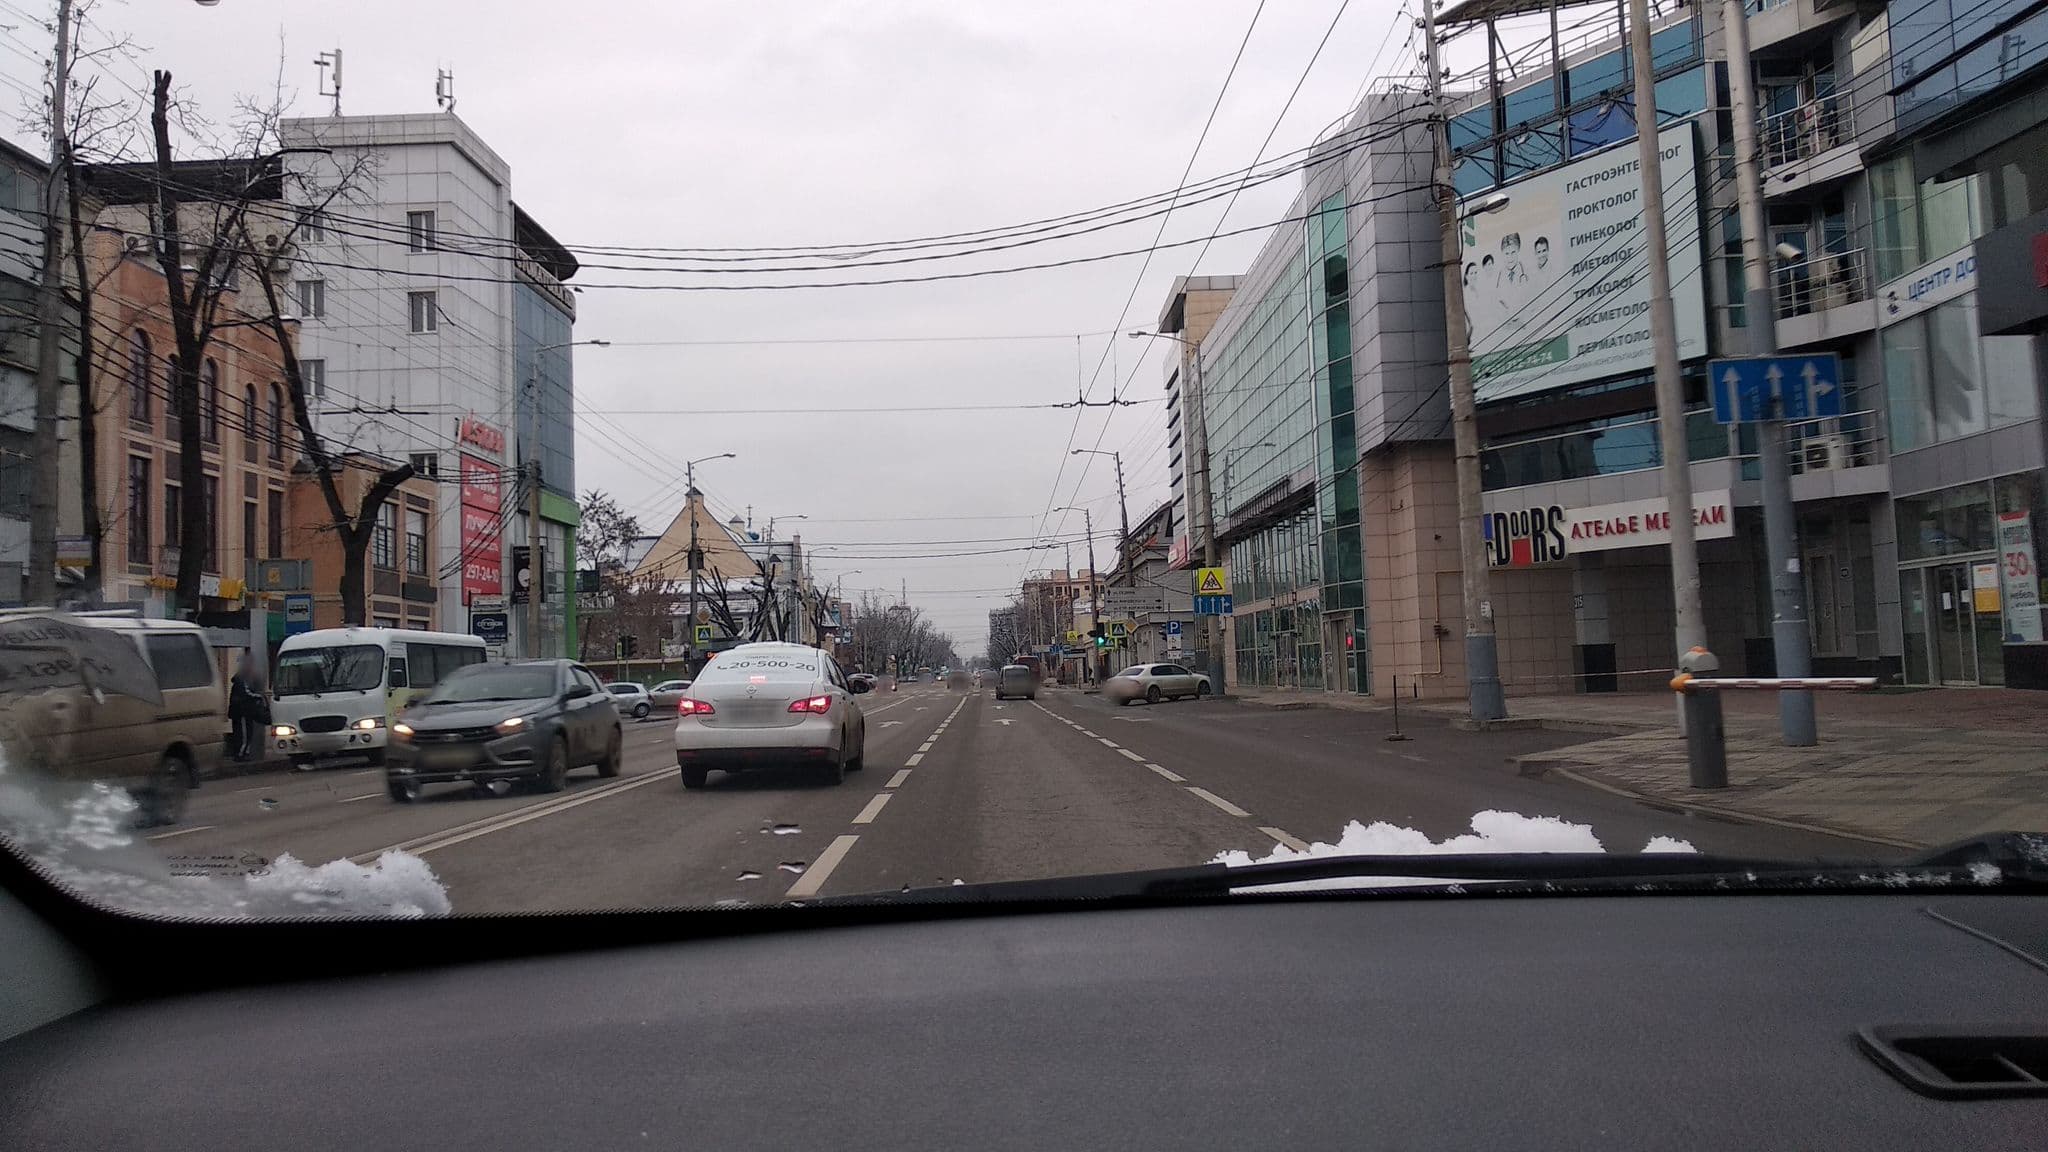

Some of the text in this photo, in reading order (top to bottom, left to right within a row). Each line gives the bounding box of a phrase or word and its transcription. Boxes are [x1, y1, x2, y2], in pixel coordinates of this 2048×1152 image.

[1566, 145, 1681, 194] ГАСТРОЭНТЕЛОГ
[1568, 188, 1638, 220] ПРОКТОЛОГ
[1570, 216, 1639, 247] ГИНЕКОЛОГ
[1571, 247, 1633, 277] ДИЕТОЛОГ
[1573, 275, 1636, 300] ТРИХОЛОГ
[1908, 267, 1951, 301] ЦЕНТР
[1575, 300, 1650, 328] КОСМЕТОЛО
[1577, 329, 1650, 357] ДЕРМАТОЛО
[1572, 505, 1726, 540] АТЕЛЬЕ МЕЕЛИ
[729, 660, 816, 672] 20-500-20
